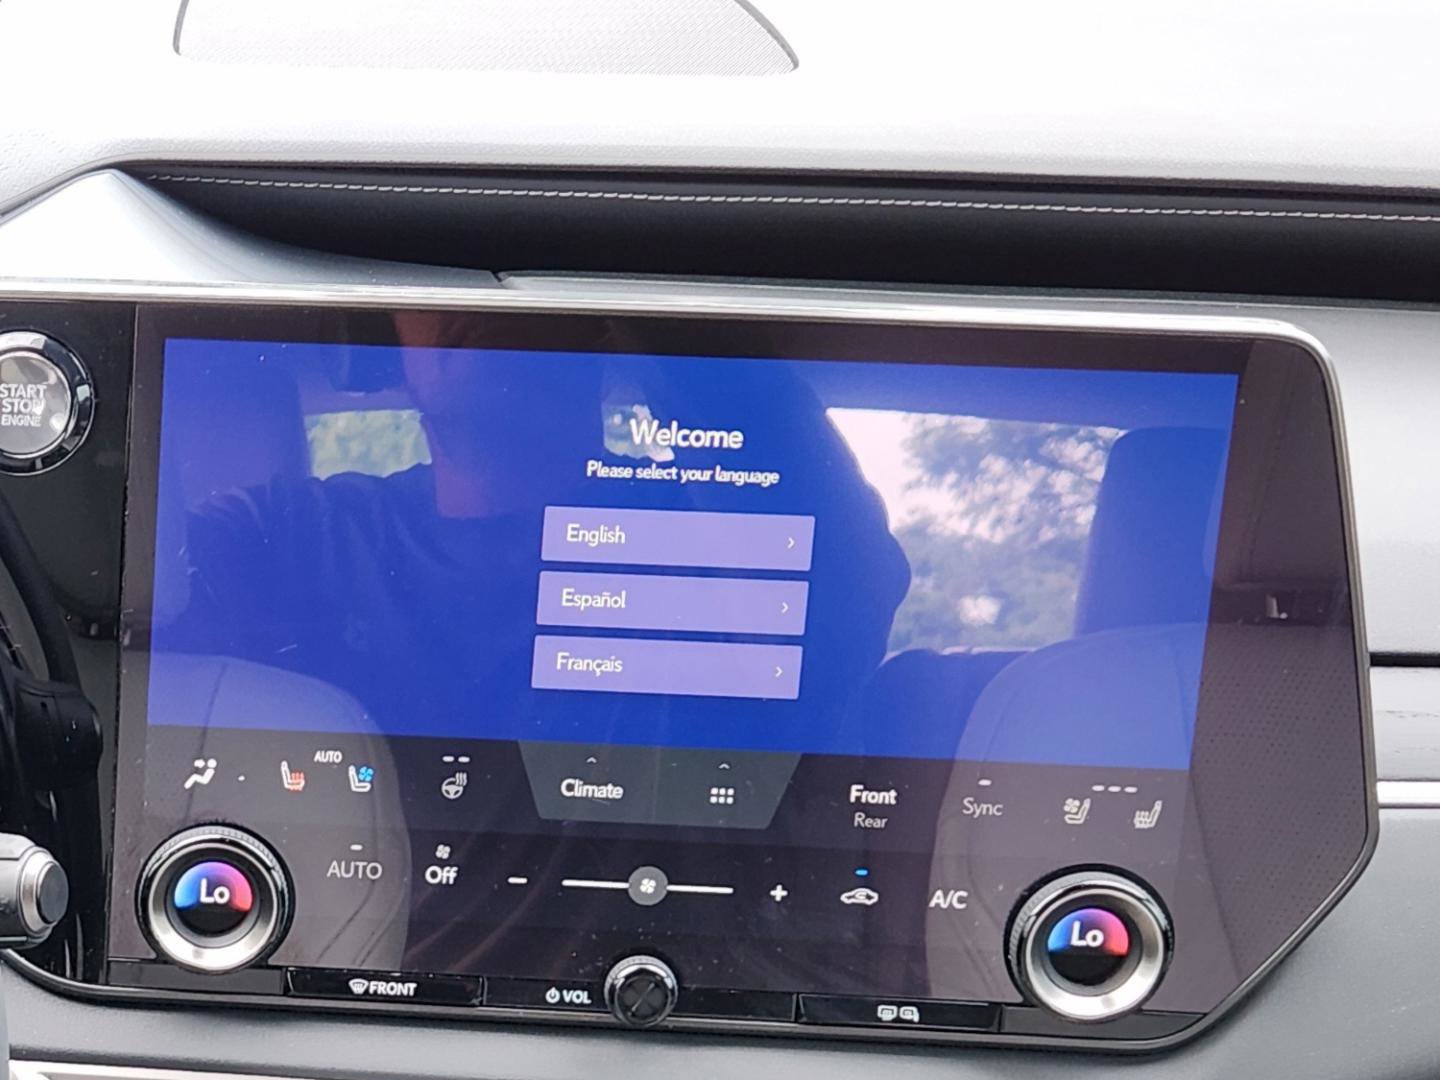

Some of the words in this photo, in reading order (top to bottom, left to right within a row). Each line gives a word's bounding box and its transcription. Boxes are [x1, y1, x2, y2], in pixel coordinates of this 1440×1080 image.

[1, 399, 46, 414] STOP
[0, 414, 42, 427] ENGINE
[629, 418, 744, 449] Welcome
[586, 460, 634, 479] Please
[635, 463, 678, 481] select
[680, 468, 714, 484] your
[715, 465, 780, 487] language
[566, 523, 626, 547] English
[561, 587, 627, 610] Español
[556, 652, 623, 677] Français
[314, 750, 343, 763] AUTO
[560, 778, 624, 799] Climate
[850, 784, 899, 805] Front
[962, 797, 1003, 818] Sync
[853, 812, 888, 829] Rear
[326, 861, 383, 880] AUTO
[424, 866, 458, 885] Off
[199, 878, 231, 904] Lo
[928, 890, 968, 910] A/C
[1070, 921, 1105, 947] Lo
[369, 981, 418, 997] FRONT
[562, 989, 592, 1004] VOL
